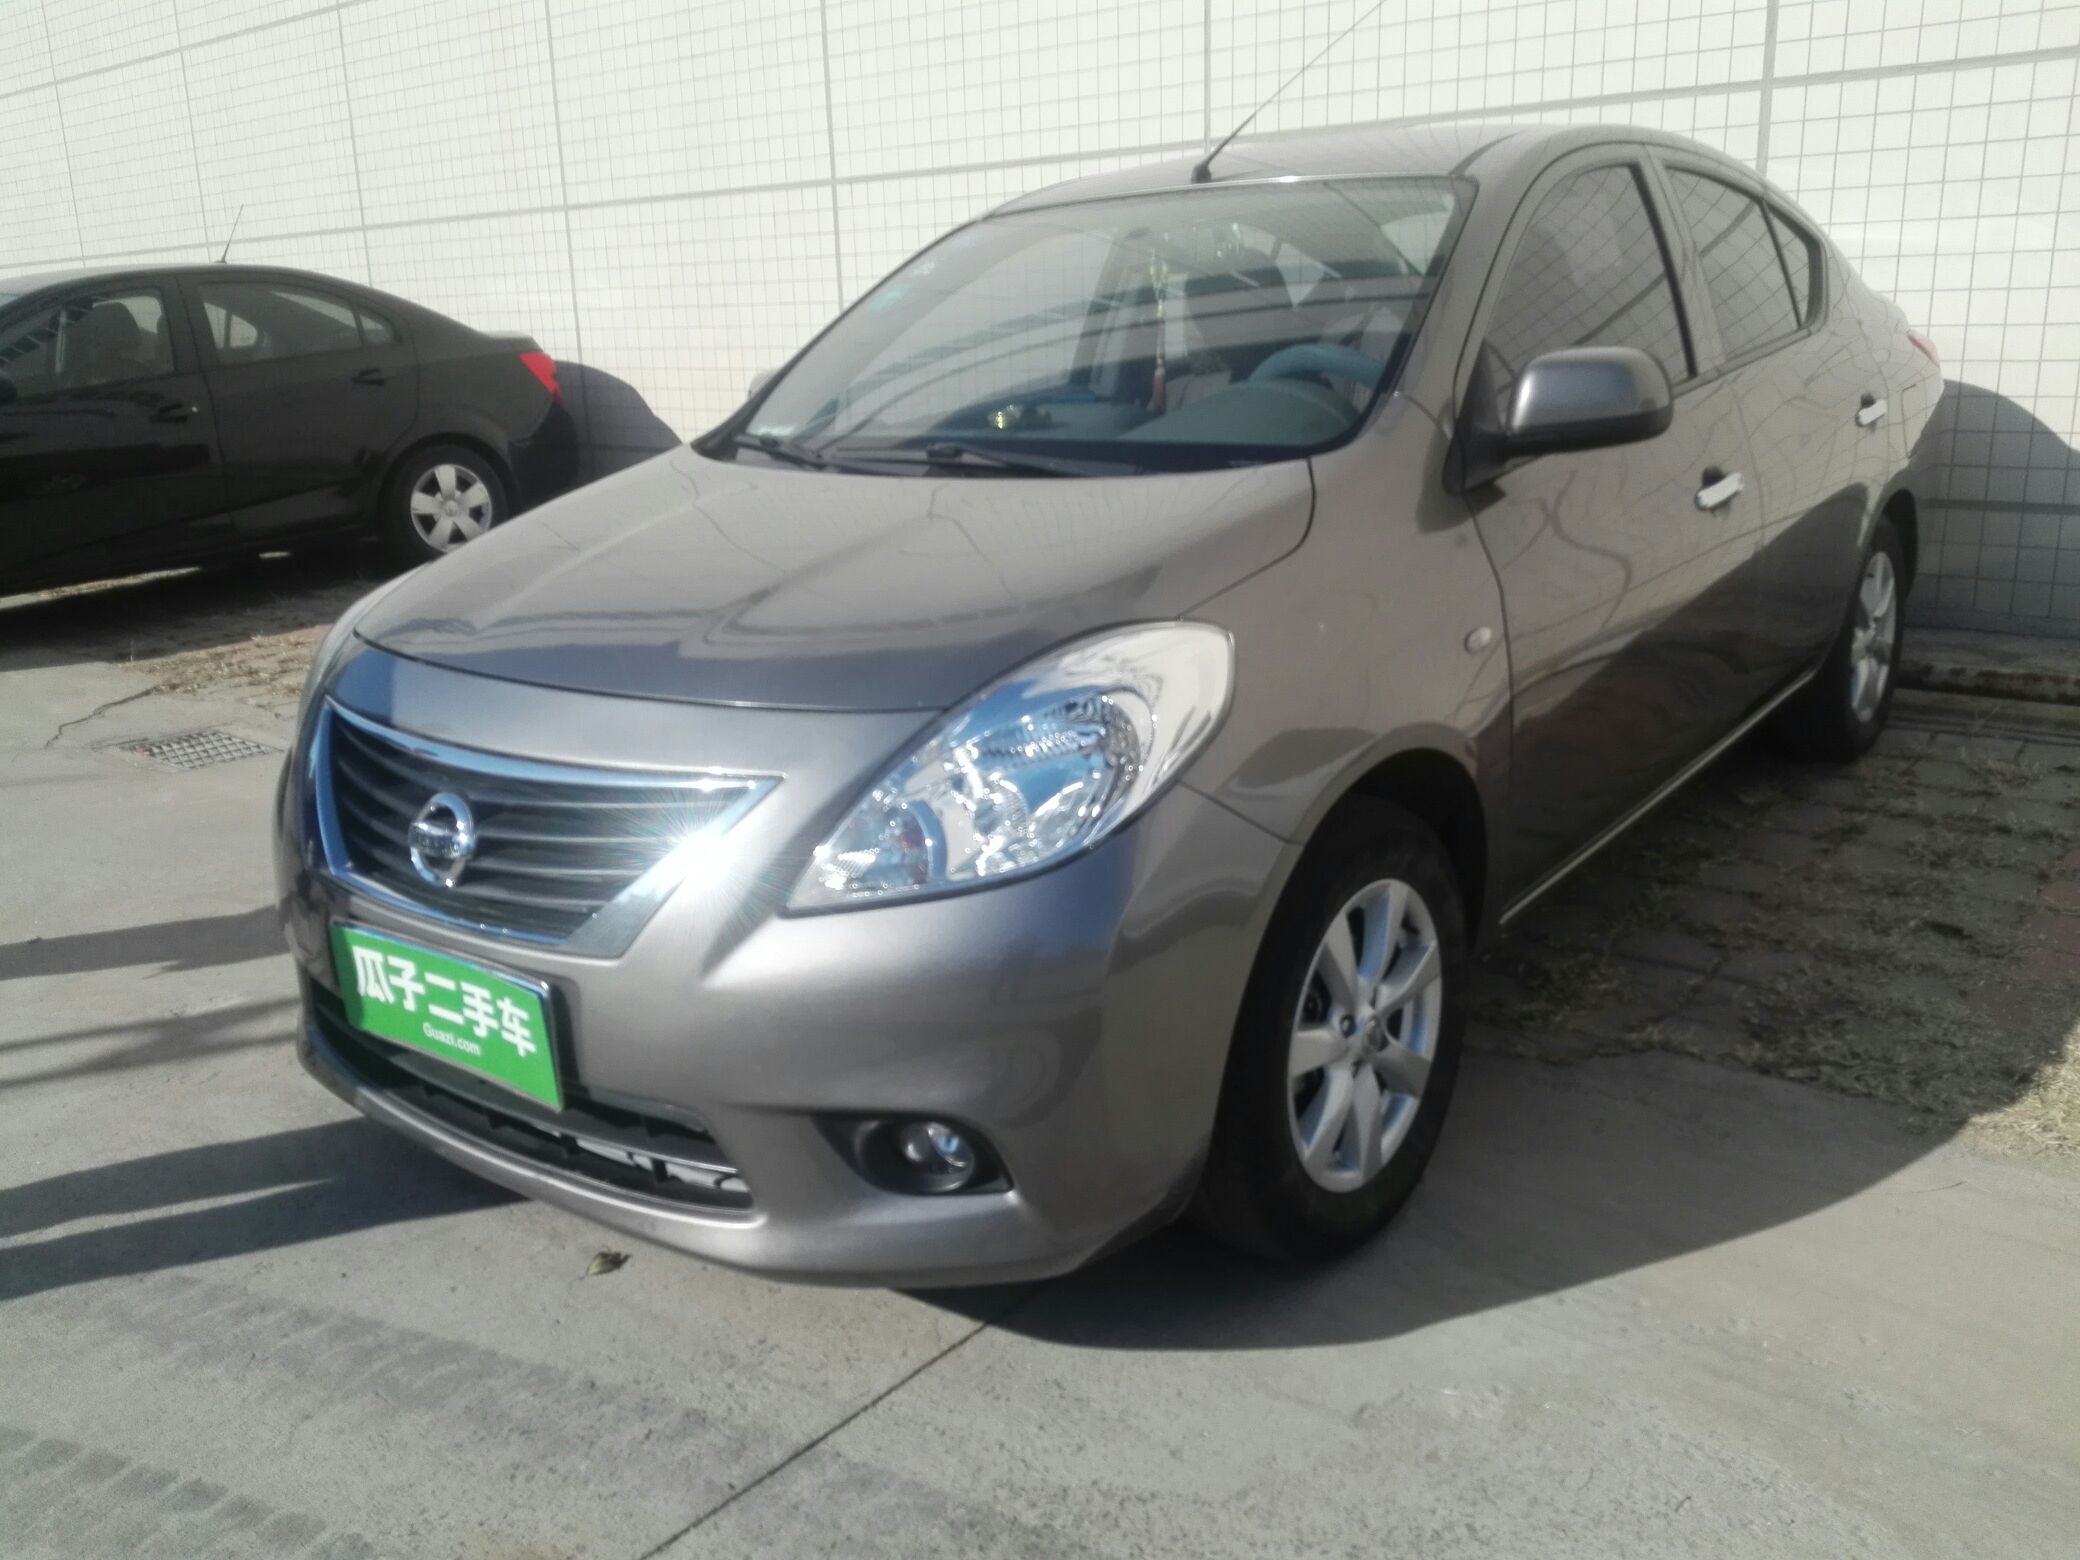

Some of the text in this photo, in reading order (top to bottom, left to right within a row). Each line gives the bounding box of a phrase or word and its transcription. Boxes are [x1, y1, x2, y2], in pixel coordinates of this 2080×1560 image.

[352, 945, 536, 1057] 瓜子二手车
[422, 1022, 481, 1056] Guazi.com
